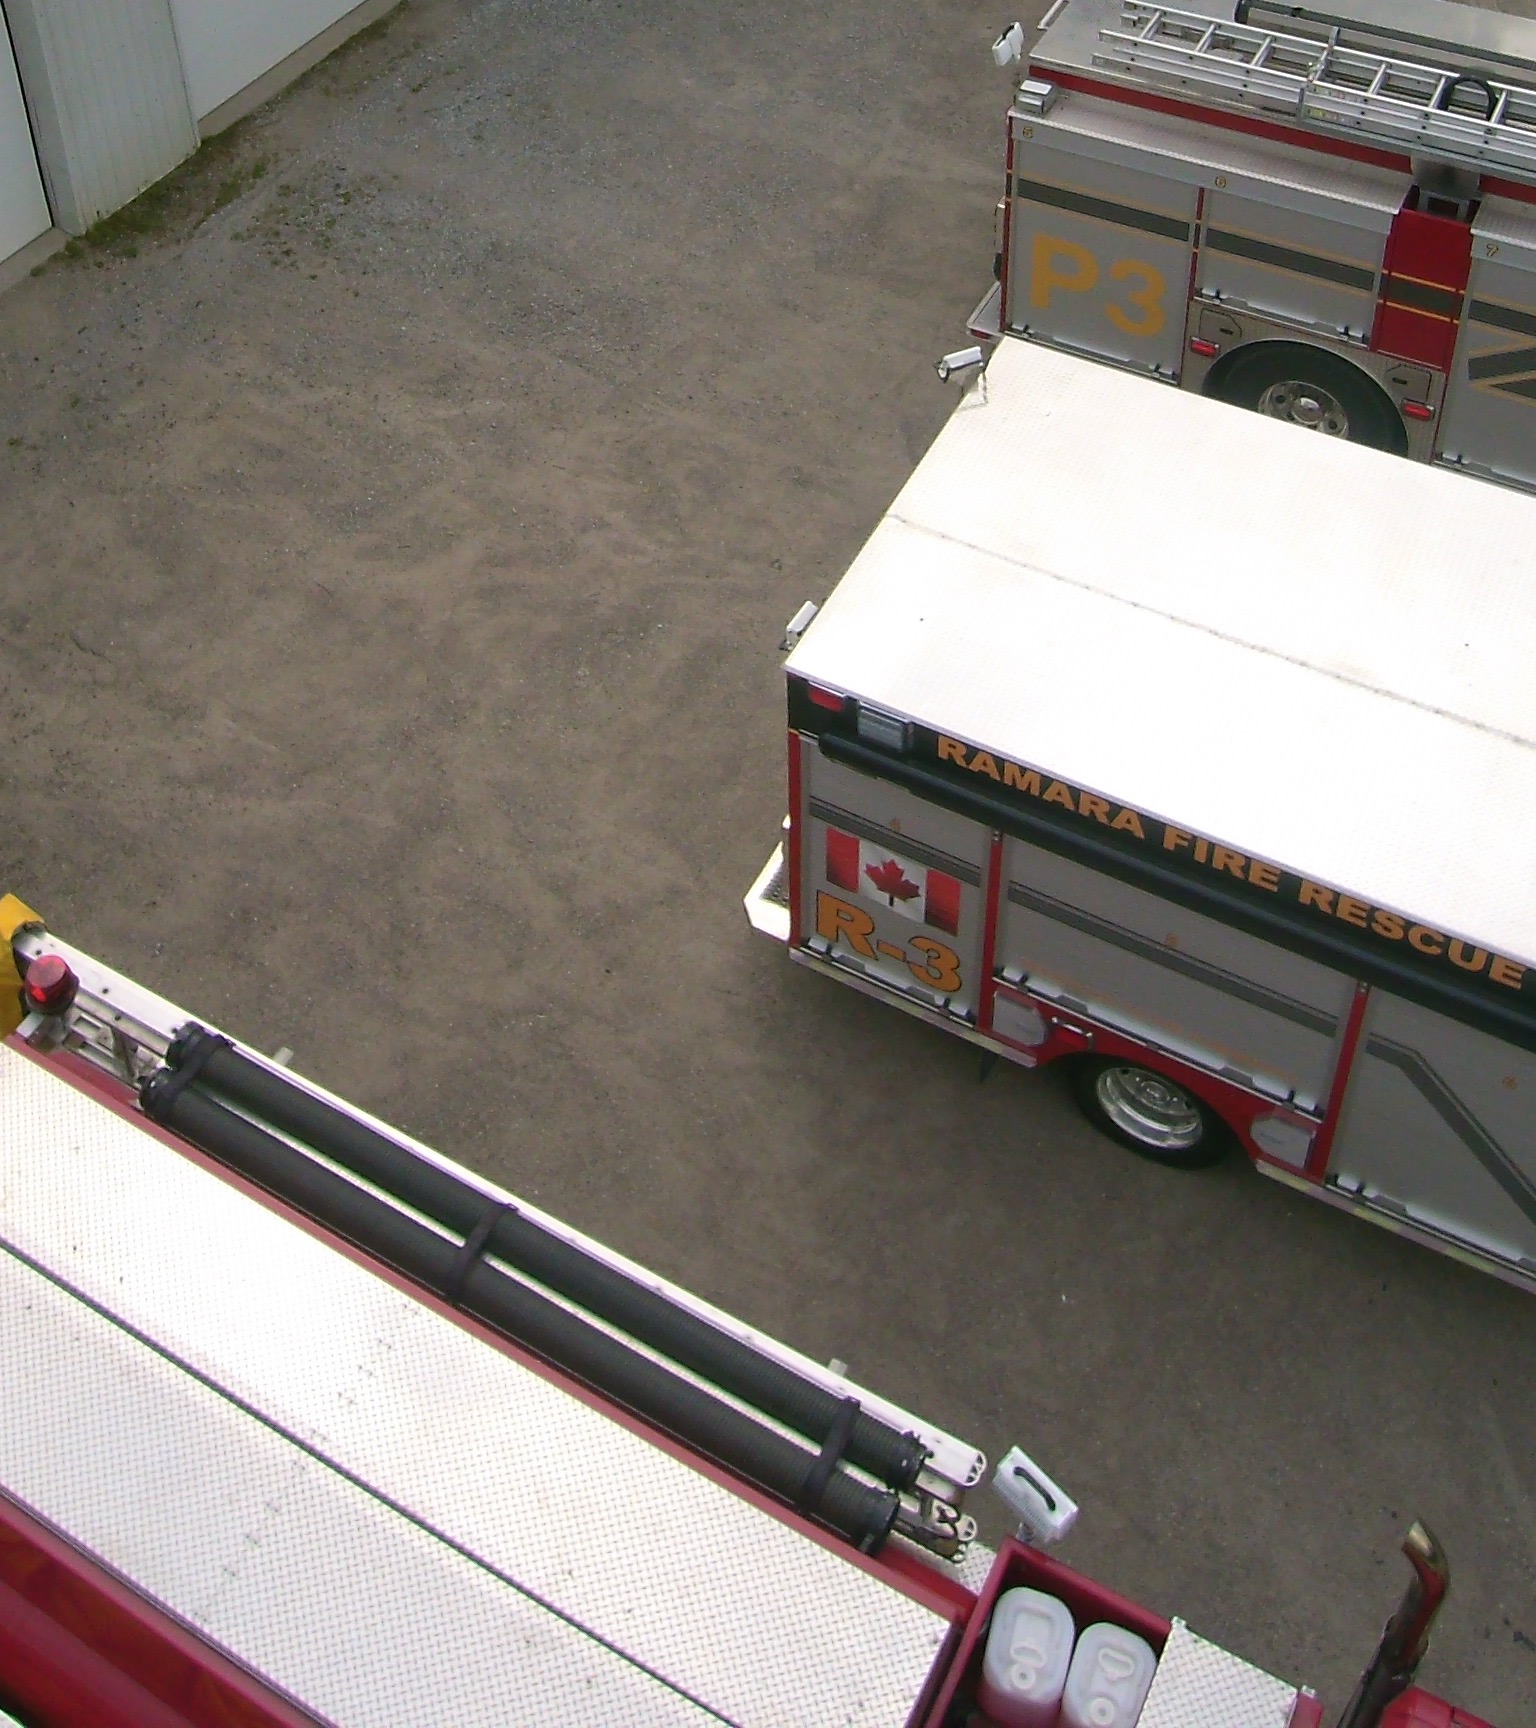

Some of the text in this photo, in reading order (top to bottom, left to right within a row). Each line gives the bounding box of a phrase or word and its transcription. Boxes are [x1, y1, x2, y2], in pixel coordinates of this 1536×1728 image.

[1030, 233, 1167, 337] P3
[937, 734, 1528, 990] RAMARA FIRE RESCUE
[816, 889, 962, 993] R-3
